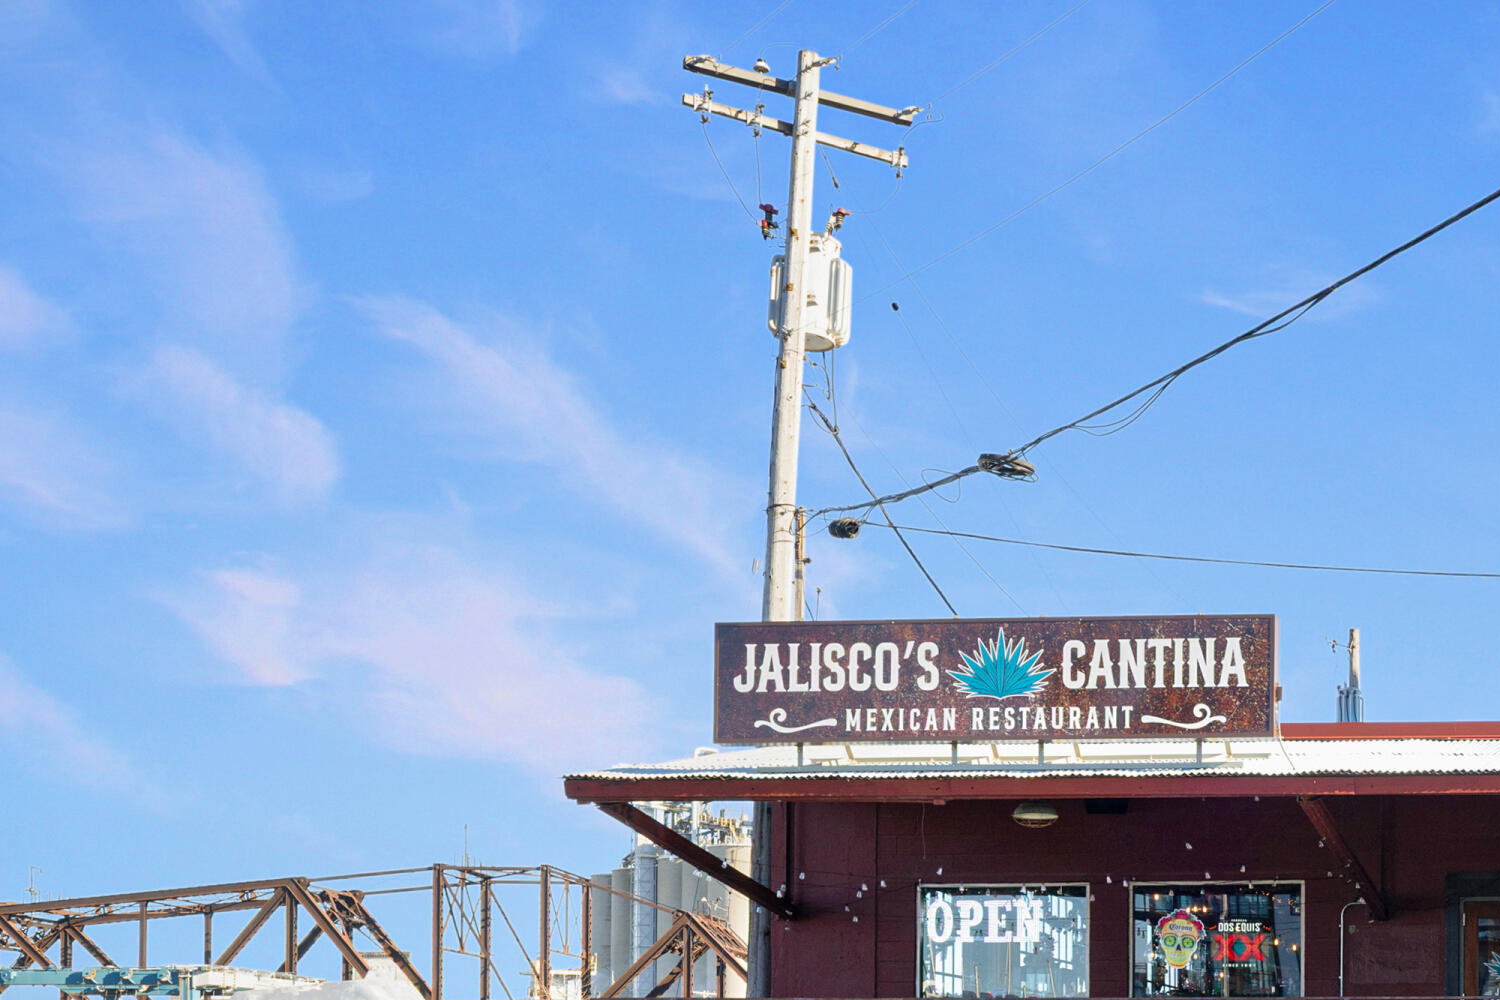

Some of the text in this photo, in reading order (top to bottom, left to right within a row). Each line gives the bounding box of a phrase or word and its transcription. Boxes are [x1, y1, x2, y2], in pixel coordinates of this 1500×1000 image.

[733, 637, 1249, 693] JALISCO'S CANTINA
[845, 705, 1134, 732] MEXICAN RESTAURANT
[927, 898, 1044, 942] OPEN
[1168, 922, 1193, 932] Corona
[1218, 922, 1235, 932] DOS
